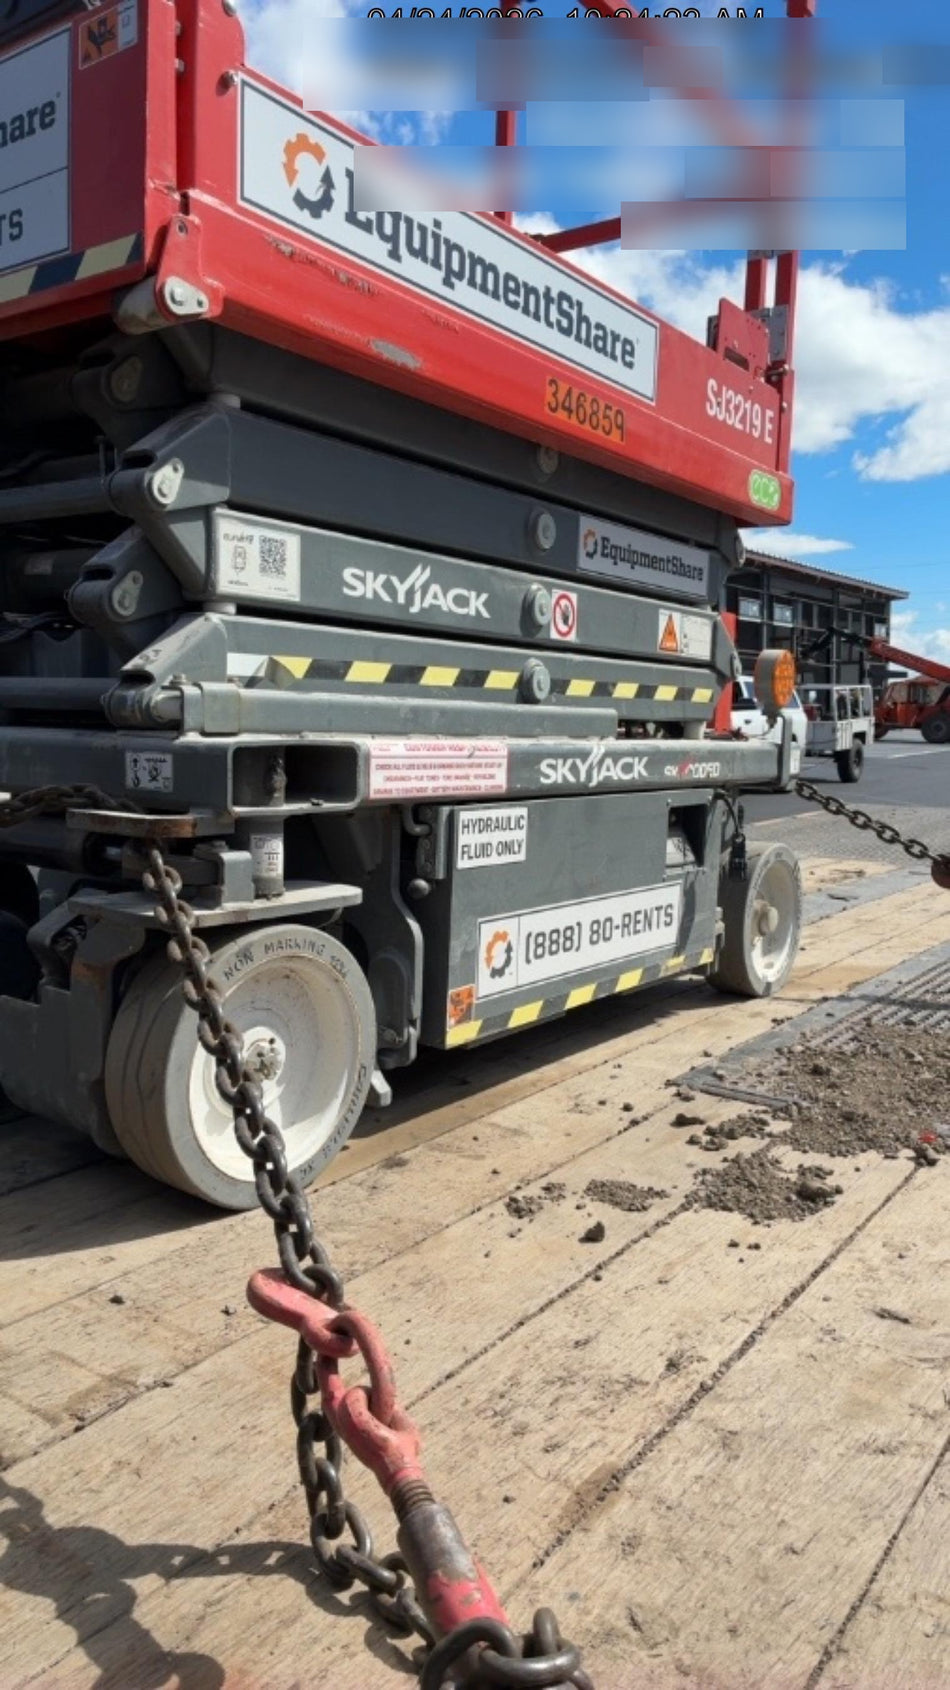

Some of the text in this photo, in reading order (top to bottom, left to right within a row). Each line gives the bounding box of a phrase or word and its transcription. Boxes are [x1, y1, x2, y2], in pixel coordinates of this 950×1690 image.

[547, 378, 625, 442] 346859
[764, 409, 775, 444] E
[600, 535, 704, 582] EquipmentShare
[342, 563, 491, 619] SKYJACK
[540, 744, 649, 788] SKYJACK
[462, 814, 525, 835] HYDRAULIC
[461, 838, 525, 861] FLUID ONLY
[525, 903, 674, 965] (888) 80-RENTS
[223, 949, 255, 980] NON
